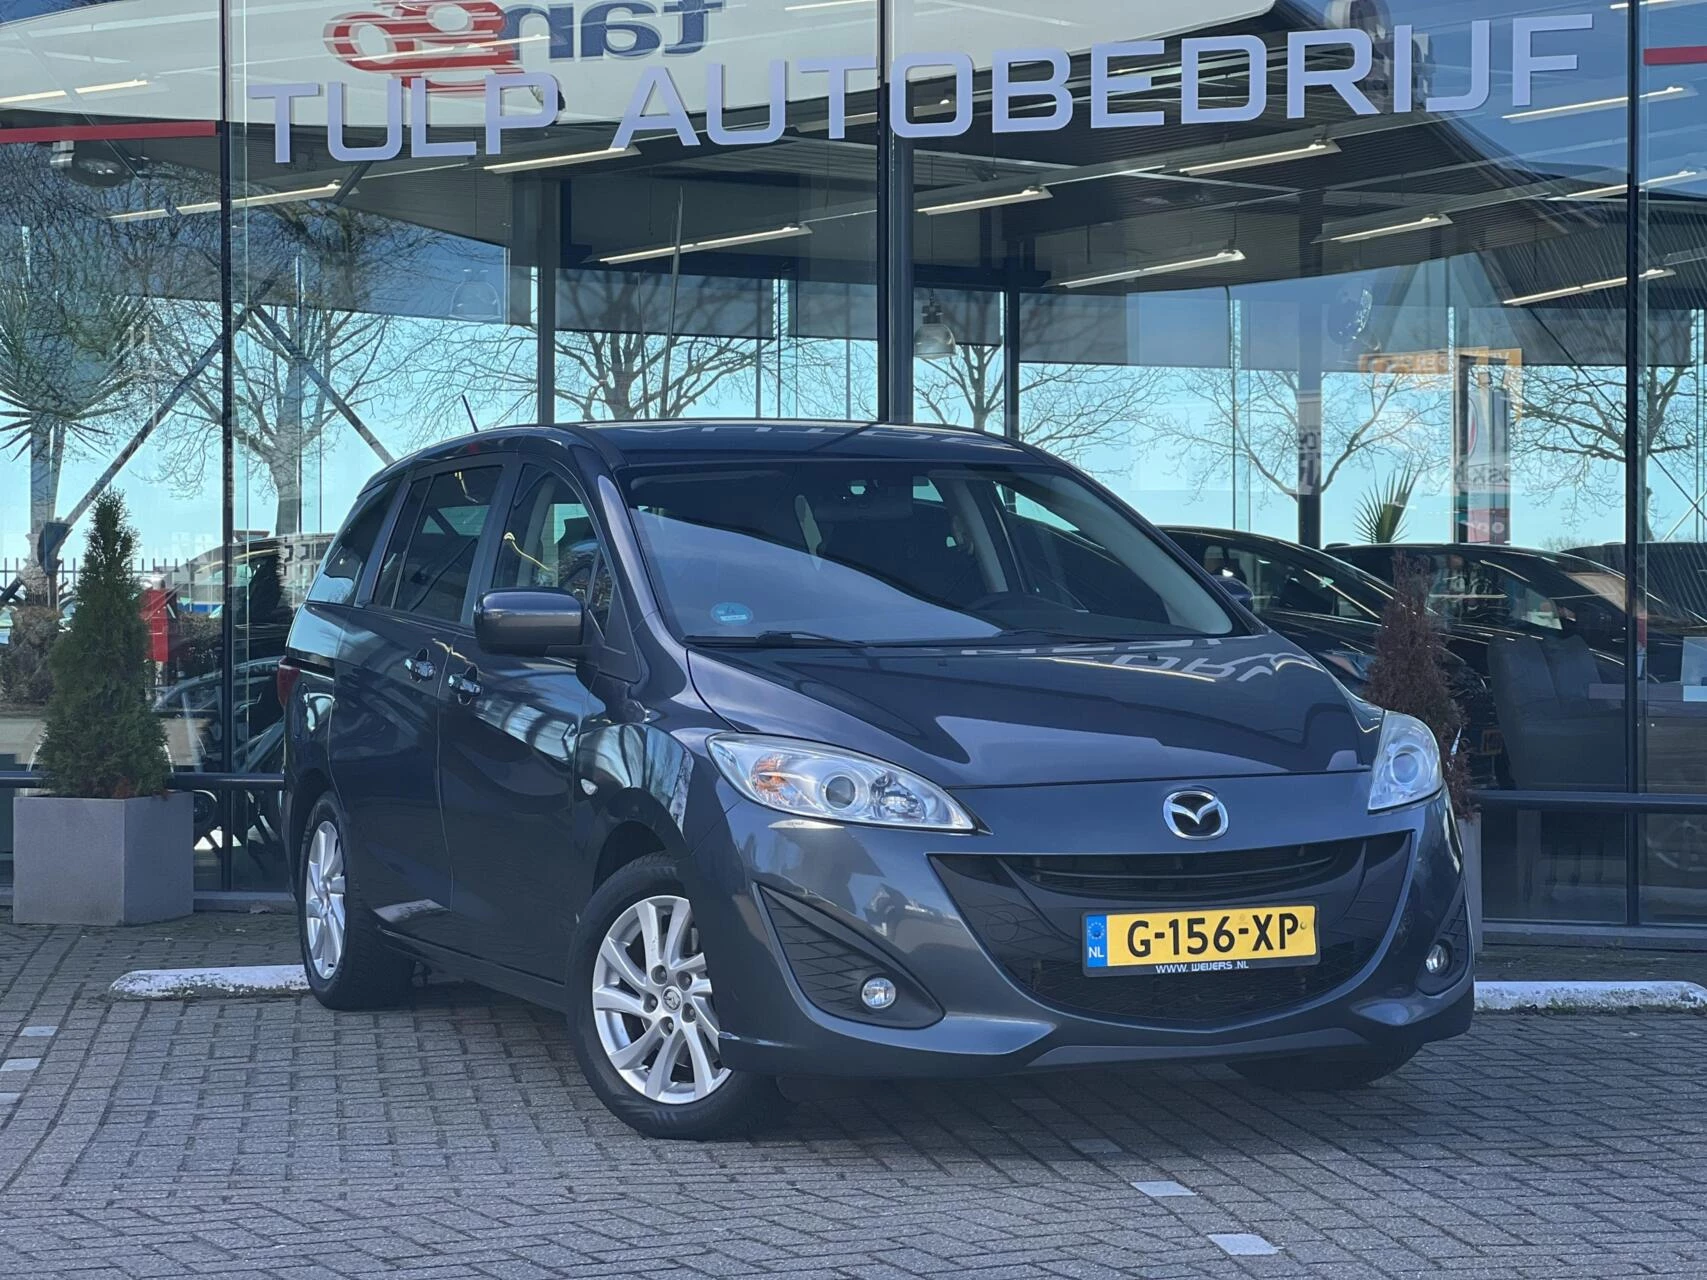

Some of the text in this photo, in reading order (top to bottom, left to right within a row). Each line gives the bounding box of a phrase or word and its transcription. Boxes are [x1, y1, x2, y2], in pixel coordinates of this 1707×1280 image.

[246, 13, 1594, 163] TULP AUTOBEDRIJF
[1087, 946, 1105, 958] NL
[1127, 912, 1299, 958] G-156-XP
